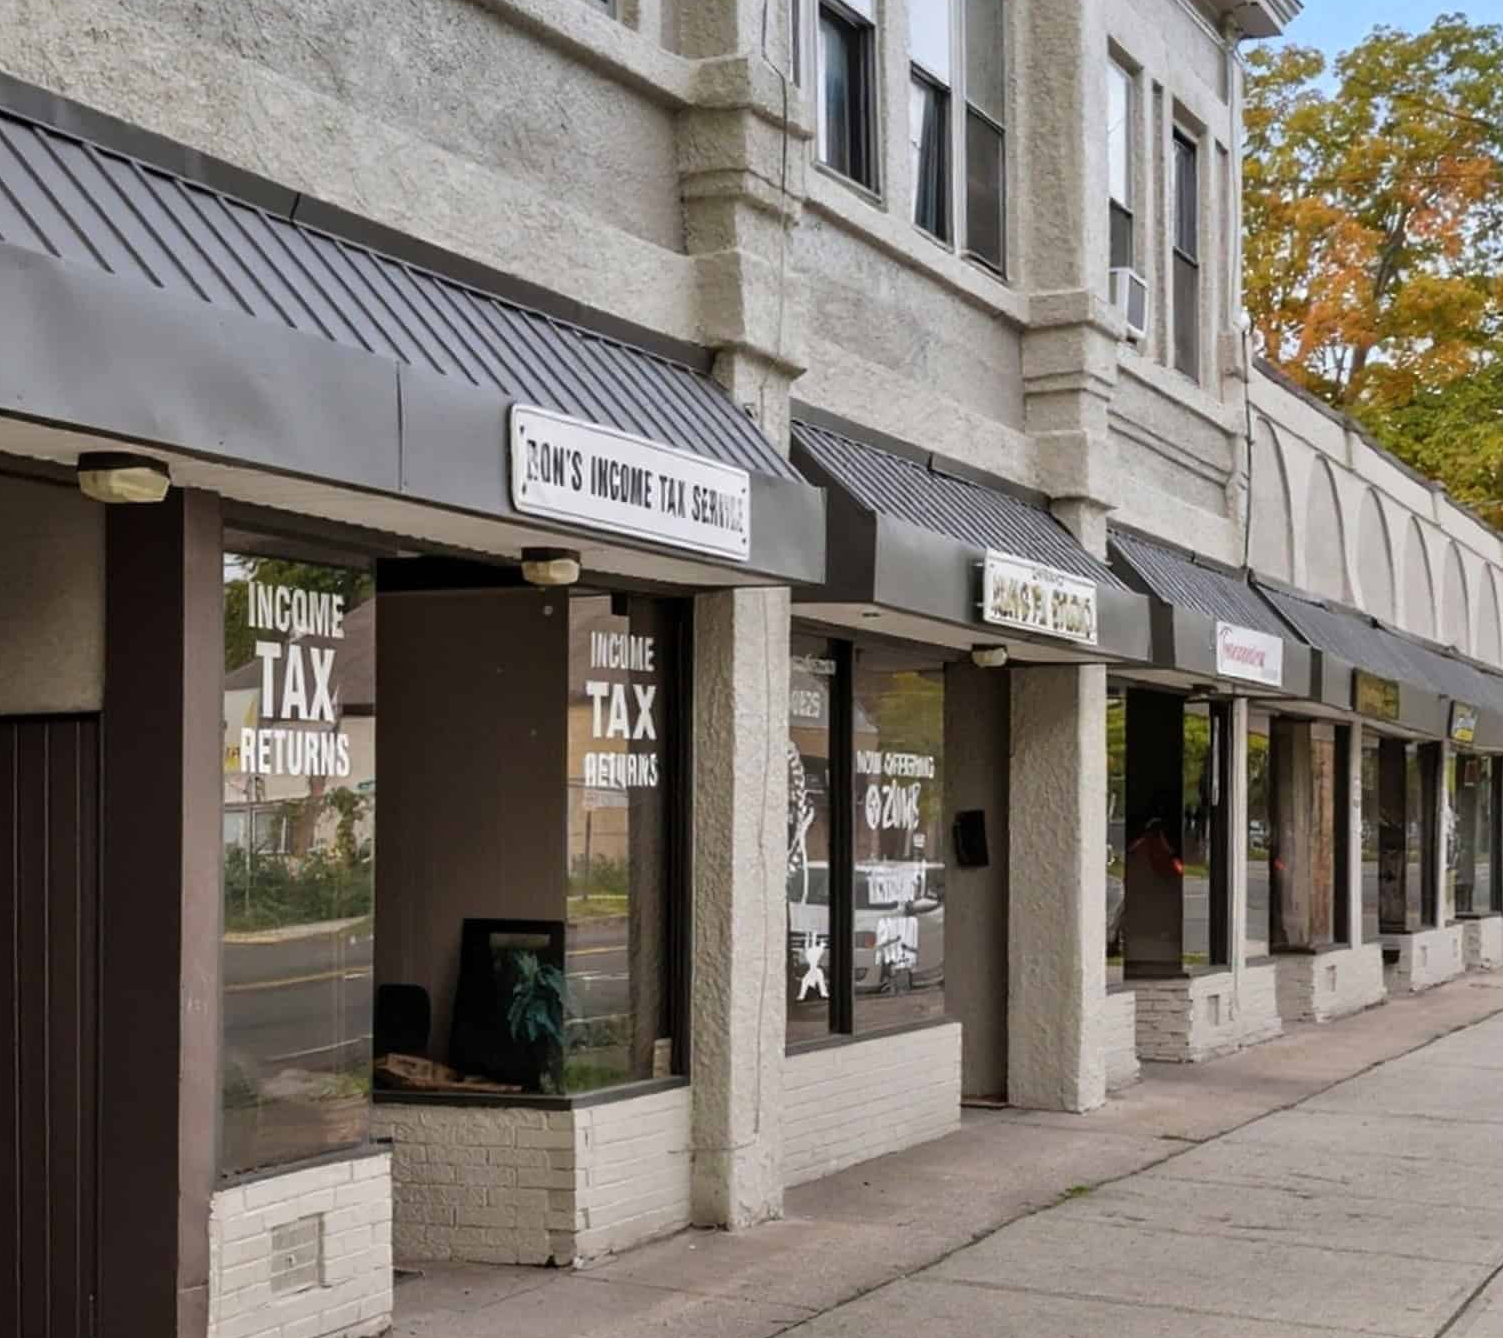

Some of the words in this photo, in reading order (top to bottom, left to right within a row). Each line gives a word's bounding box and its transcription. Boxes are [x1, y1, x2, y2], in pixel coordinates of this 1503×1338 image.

[590, 456, 653, 509] INCOME
[659, 474, 687, 519] TAX
[248, 581, 345, 639] INCOME
[590, 630, 655, 672] INCOME
[255, 640, 337, 723] TAX
[585, 679, 658, 741] TAX
[240, 727, 351, 778] RETURNS
[583, 751, 659, 790] RETURNS
